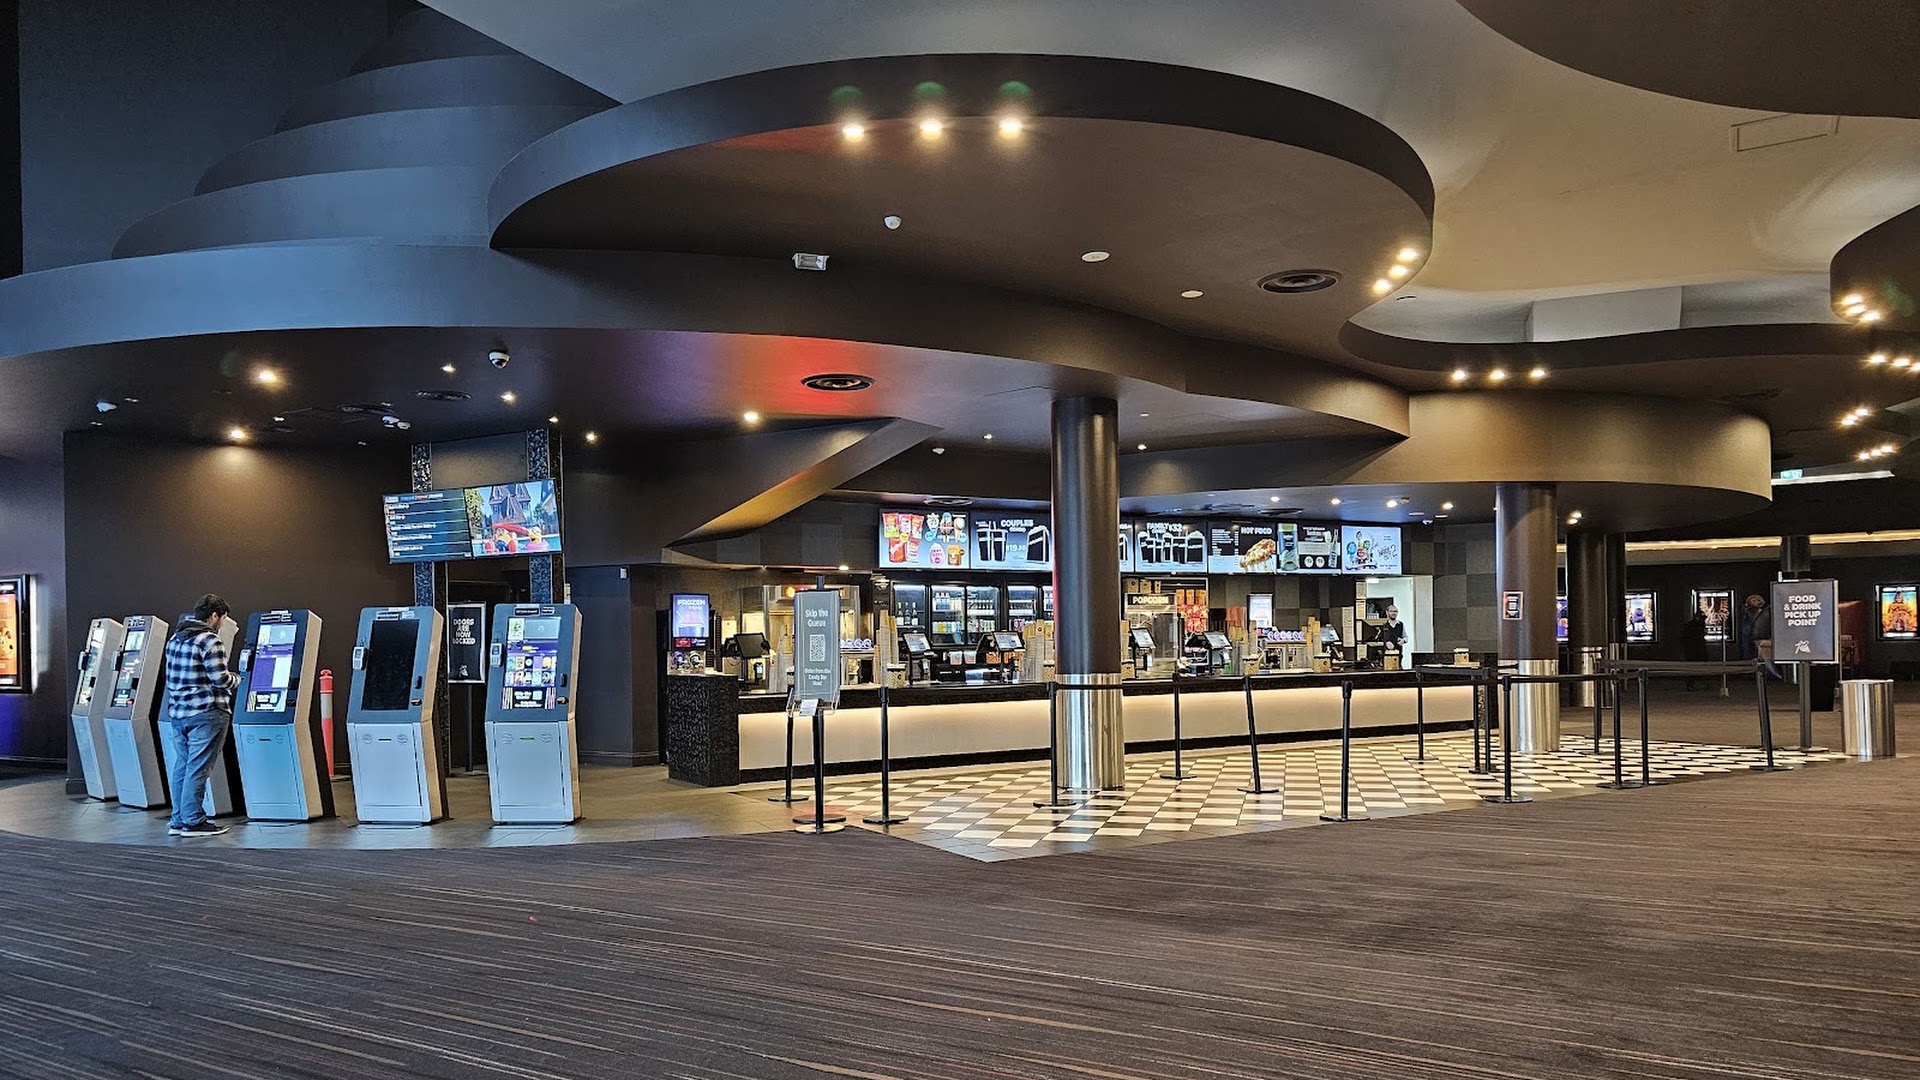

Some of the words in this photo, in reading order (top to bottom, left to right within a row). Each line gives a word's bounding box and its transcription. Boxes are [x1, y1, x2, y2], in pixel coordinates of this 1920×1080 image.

[1001, 519, 1034, 527] COUPLES
[1241, 526, 1254, 534] HOT
[1255, 527, 1272, 535] FOOD
[1132, 596, 1169, 604] POPCORN
[1783, 603, 1791, 611] &
[1791, 602, 1822, 611] DRINK
[805, 609, 818, 619] Skip
[818, 609, 829, 618] the
[1784, 611, 1807, 619] PICK
[807, 619, 826, 627] Queue
[452, 637, 476, 645] LOCKED
